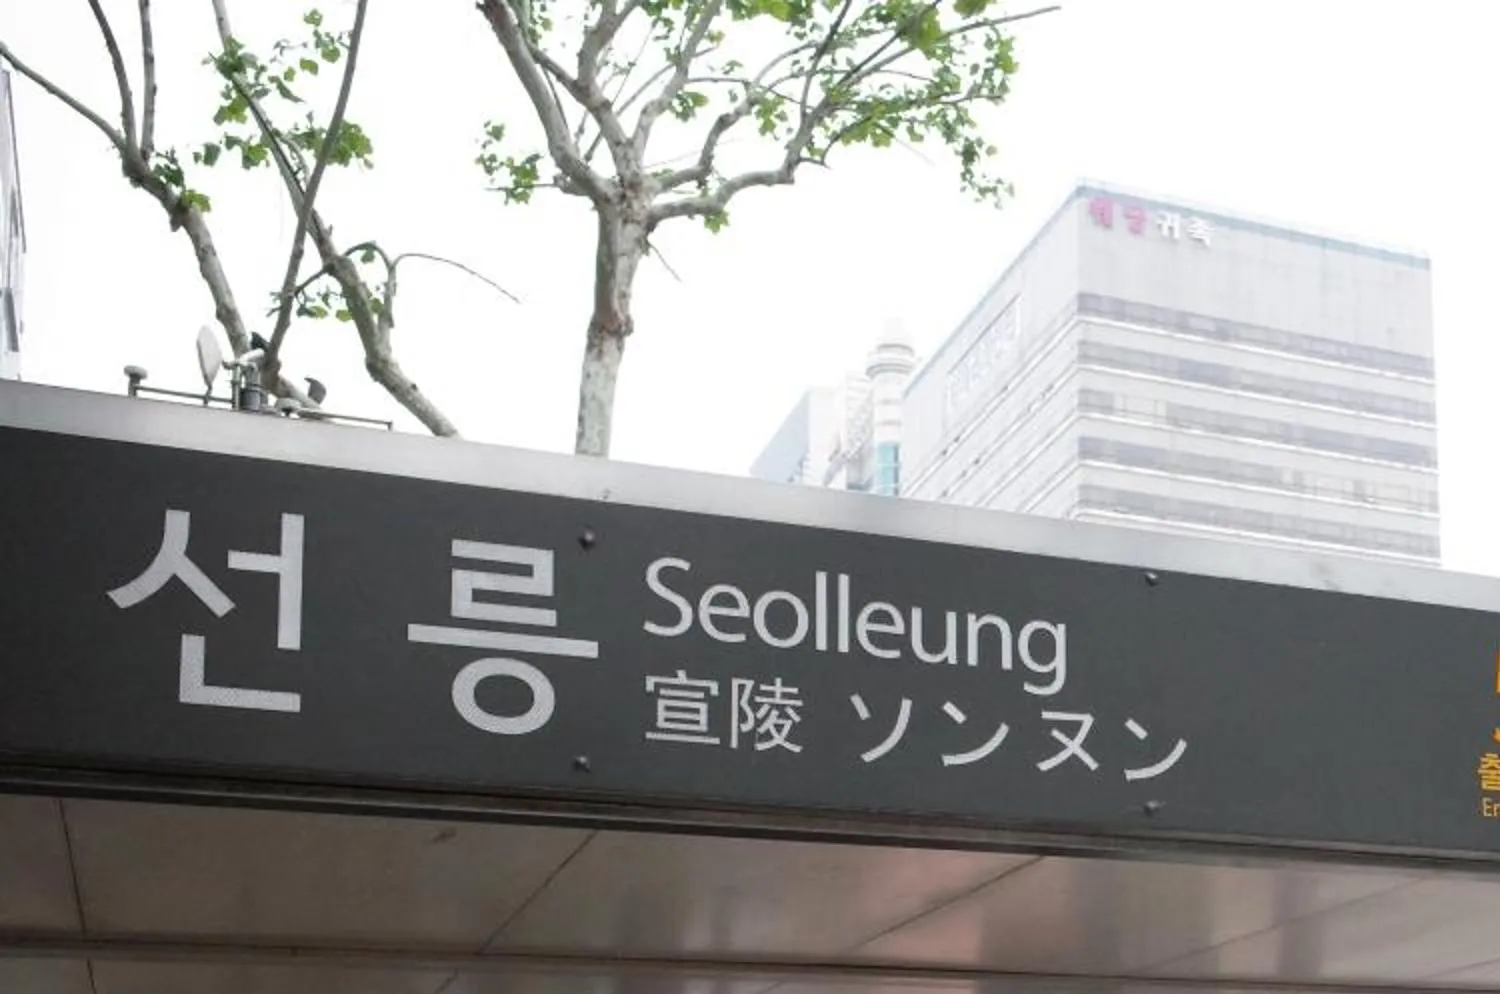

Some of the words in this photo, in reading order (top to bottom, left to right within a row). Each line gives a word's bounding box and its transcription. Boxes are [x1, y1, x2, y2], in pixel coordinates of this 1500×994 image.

[106, 508, 599, 735] 선릉
[643, 557, 1067, 695] Seolleung
[644, 669, 803, 753] 宣陵
[849, 693, 1188, 781] ソンヌン
